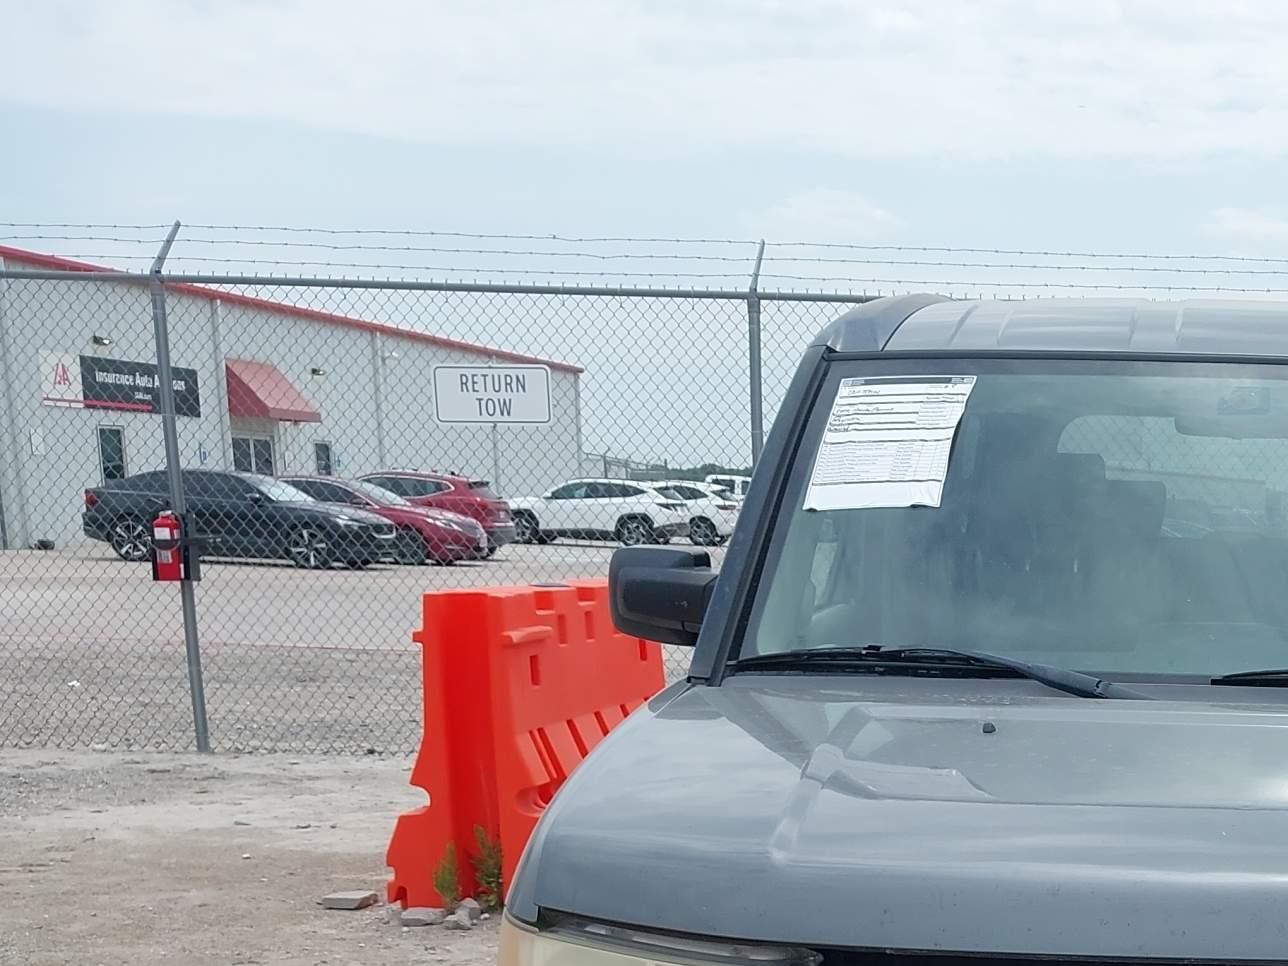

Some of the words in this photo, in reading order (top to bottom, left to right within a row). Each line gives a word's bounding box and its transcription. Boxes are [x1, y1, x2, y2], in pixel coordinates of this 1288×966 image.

[95, 370, 134, 386] Insurance
[135, 372, 153, 388] Auto
[459, 373, 527, 393] RETURN
[476, 398, 512, 417] TOW
